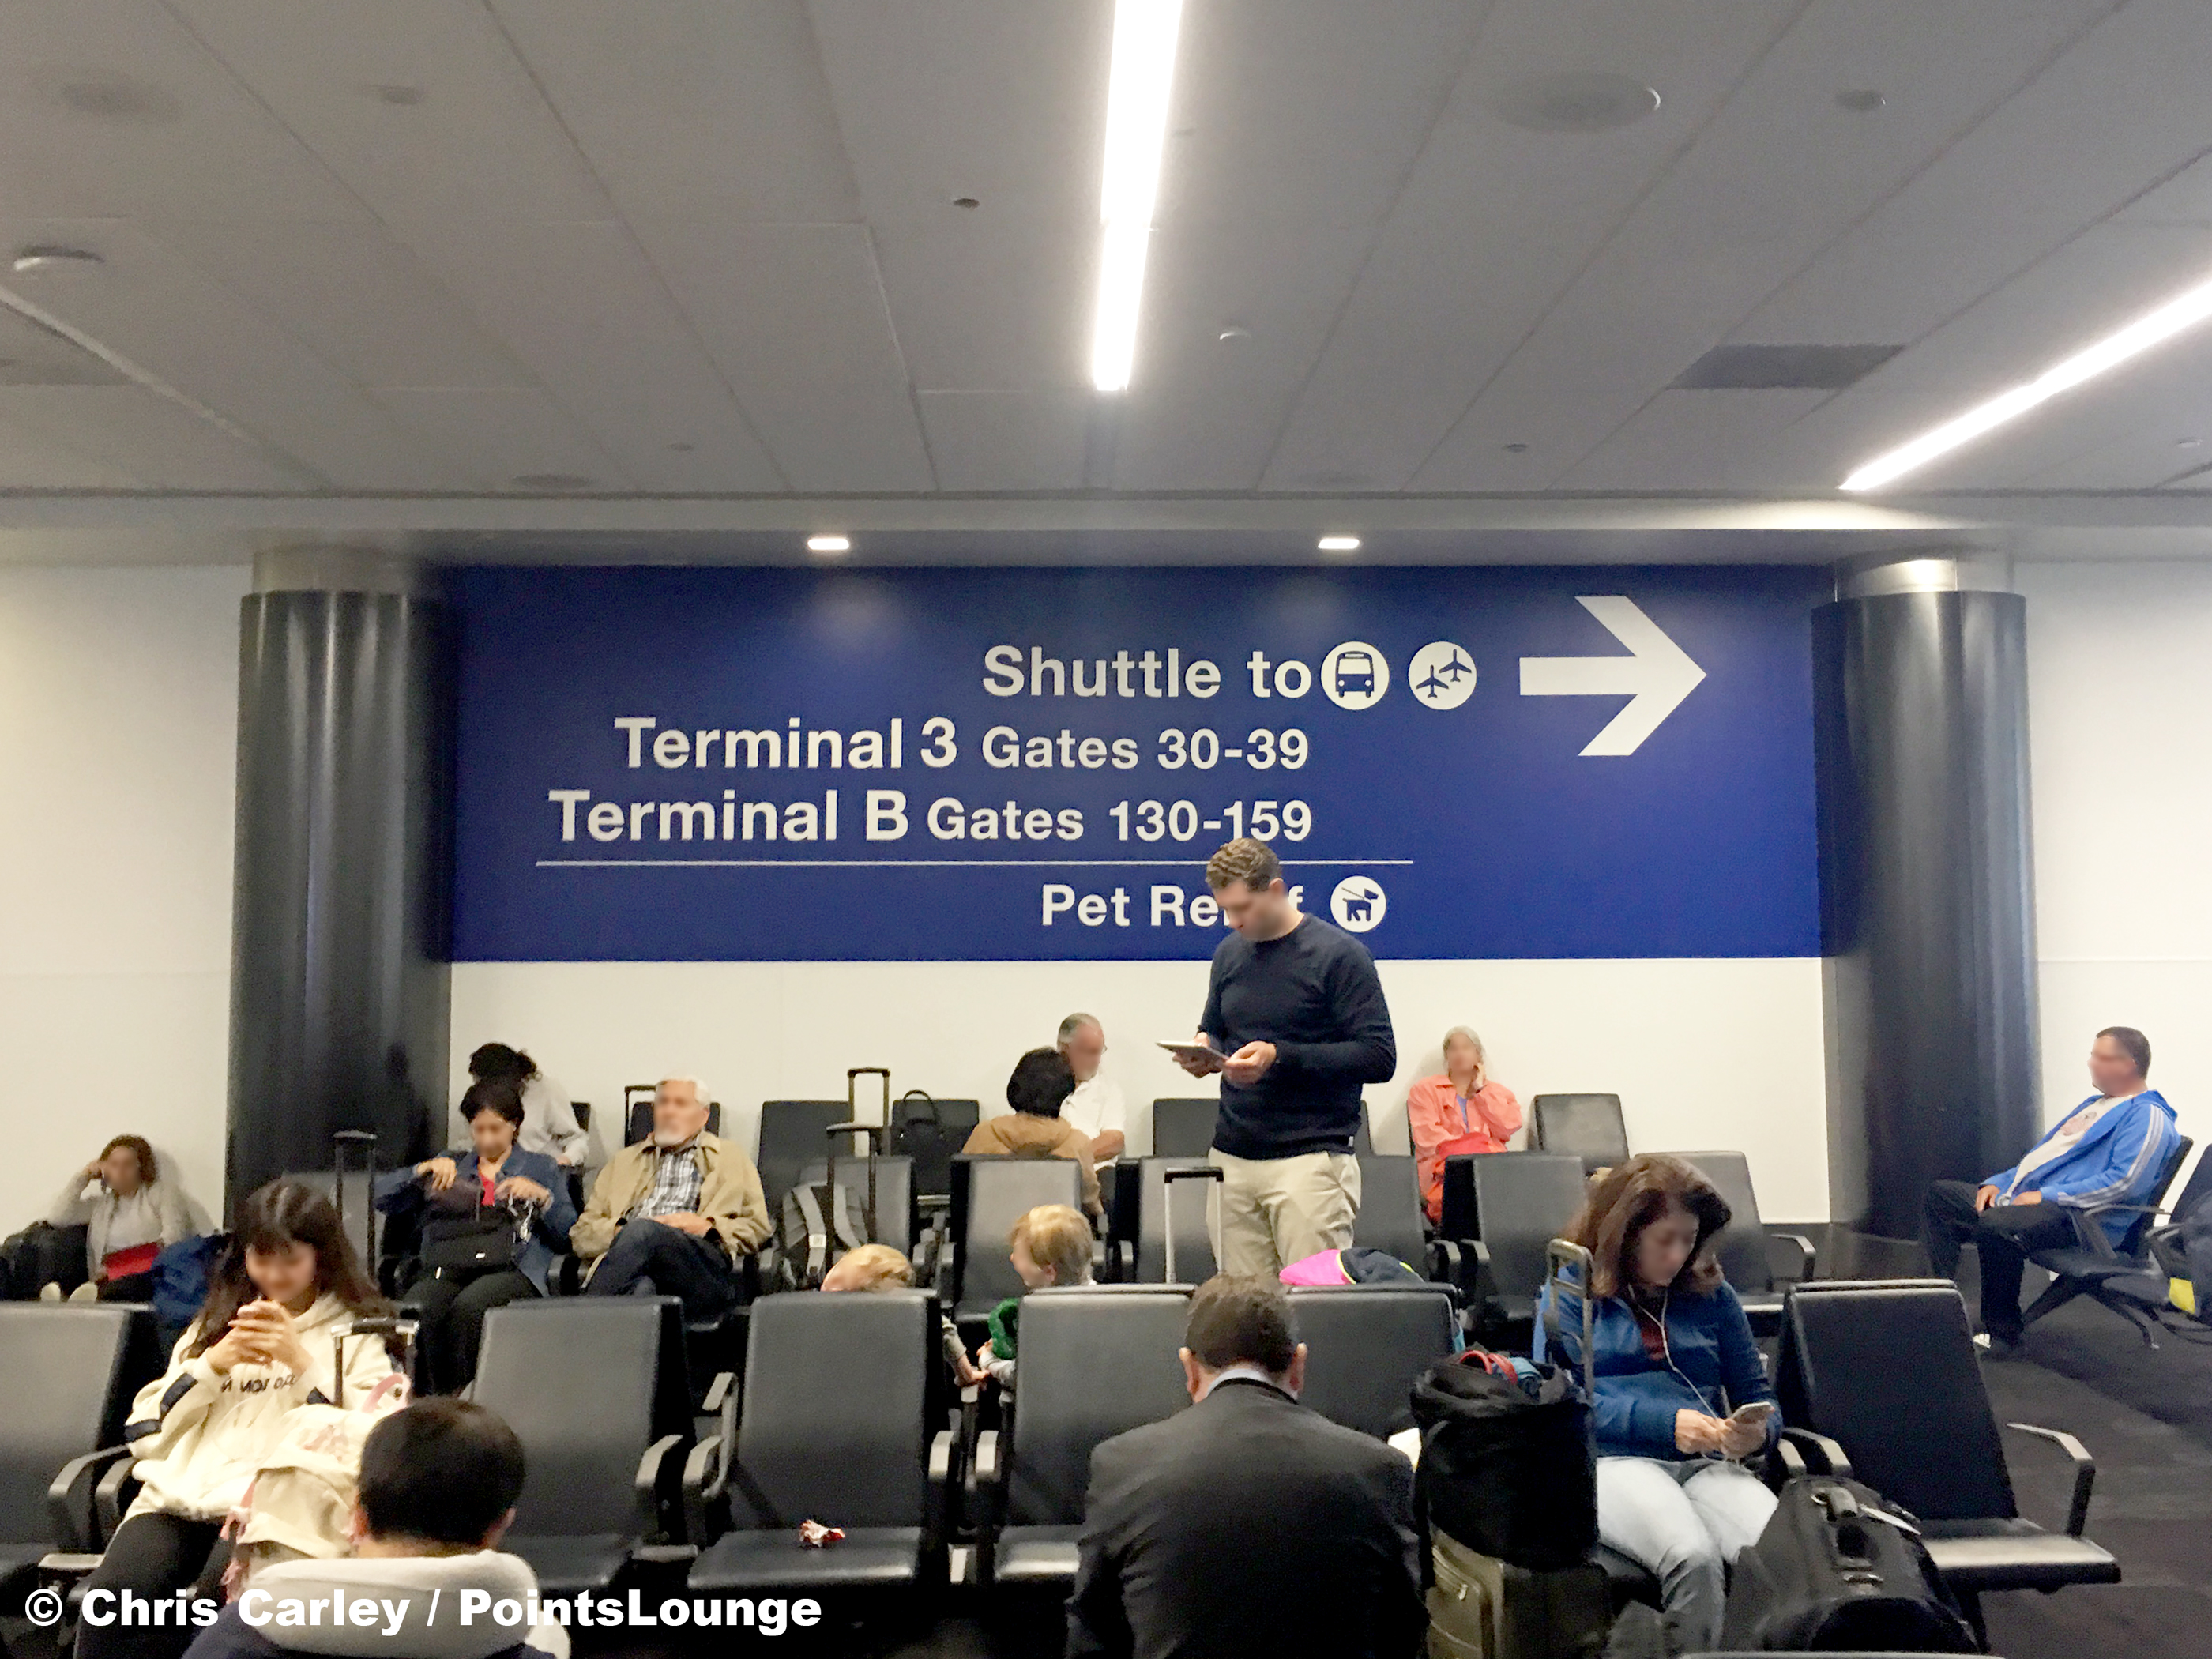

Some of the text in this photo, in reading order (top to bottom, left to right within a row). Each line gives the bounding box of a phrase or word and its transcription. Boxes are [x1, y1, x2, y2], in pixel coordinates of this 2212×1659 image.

[982, 645, 1311, 699] Shuttle to
[614, 716, 1310, 770] Terminal 3 Gates 30-39
[548, 788, 1312, 842] Terminal B Gates 130-159
[1042, 883, 1304, 927] Pet Ref
